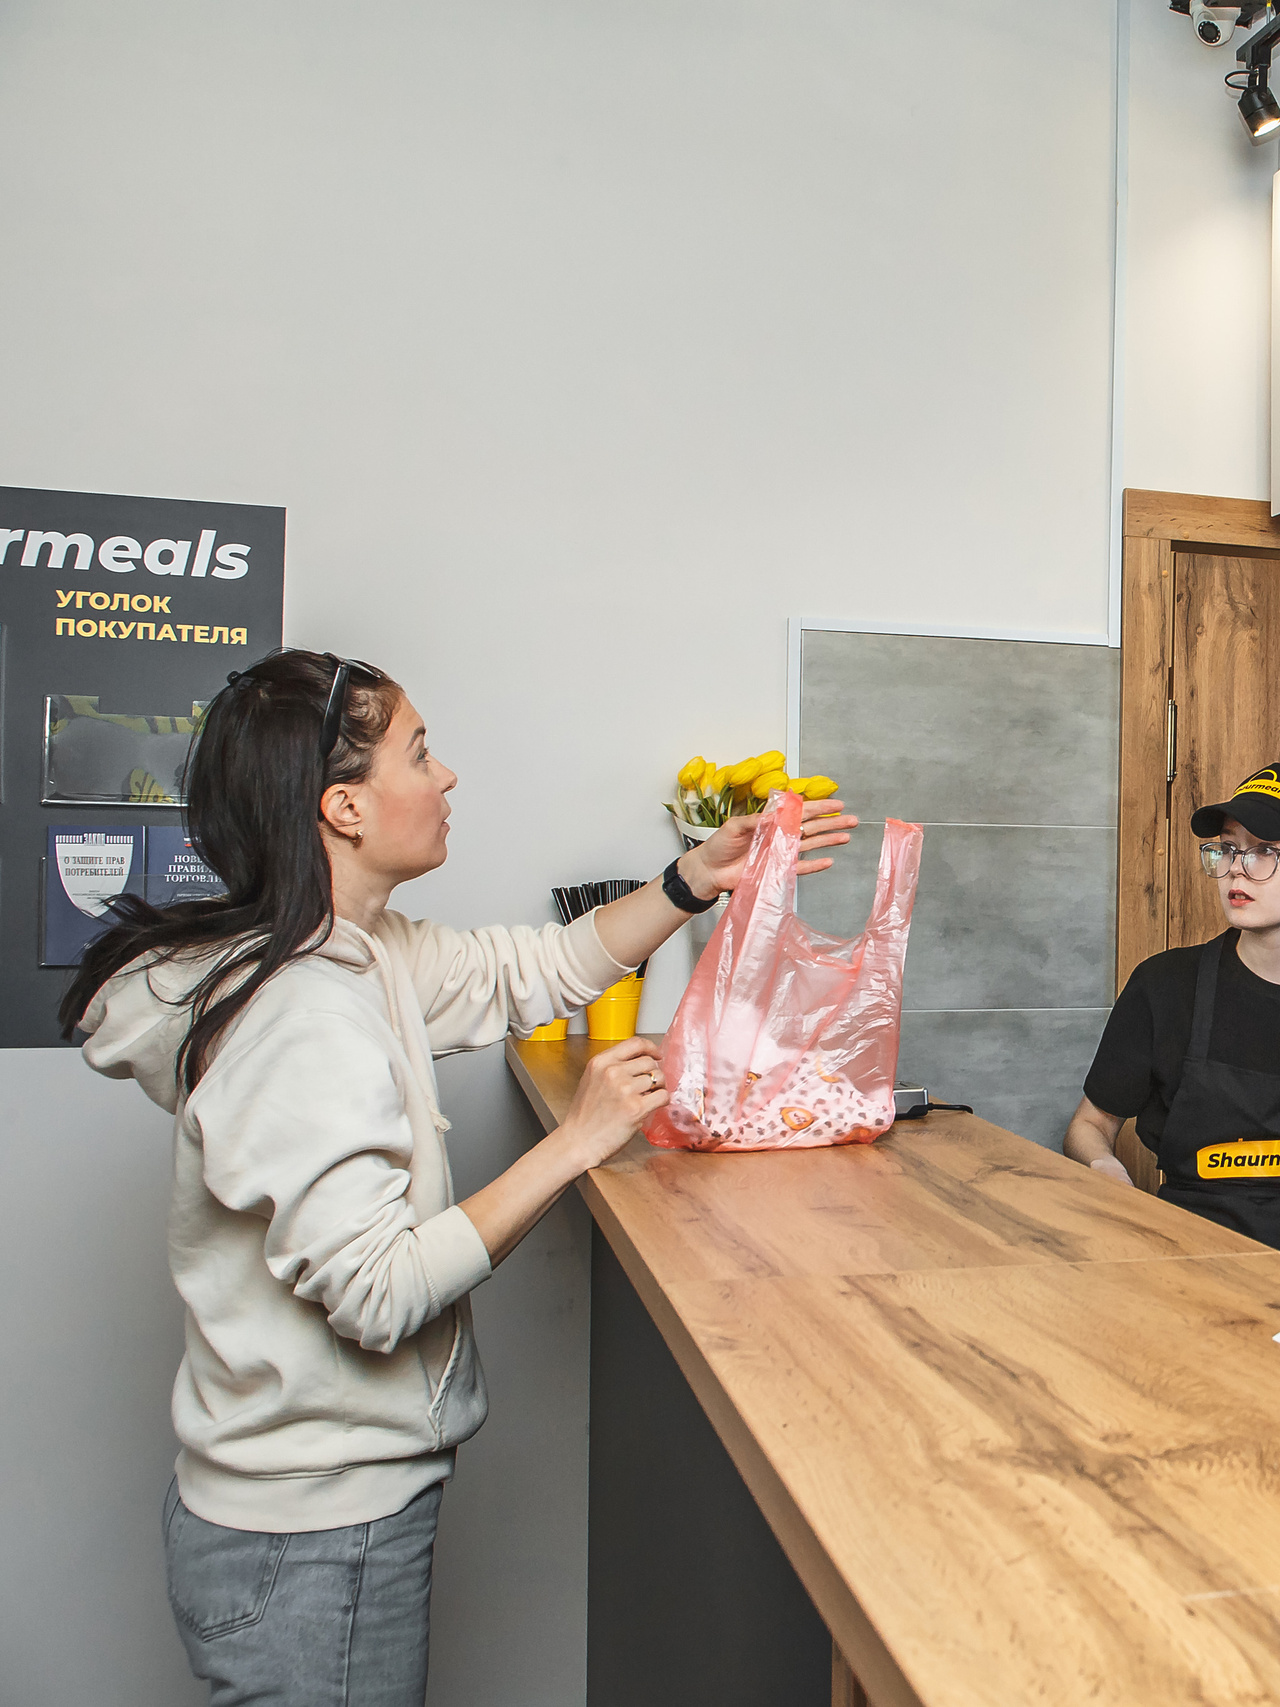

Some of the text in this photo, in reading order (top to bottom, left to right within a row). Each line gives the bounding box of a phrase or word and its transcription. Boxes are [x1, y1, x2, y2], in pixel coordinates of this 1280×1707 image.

[0, 528, 251, 580] rmeals
[55, 589, 172, 614] УГОЛОК
[55, 617, 248, 645] ПОКУПАТЕЛЯ
[64, 856, 126, 866] О ЗАЩИТЕ ПРАВ
[65, 866, 125, 877] ПОТРЕБИТЕЛЕЙ
